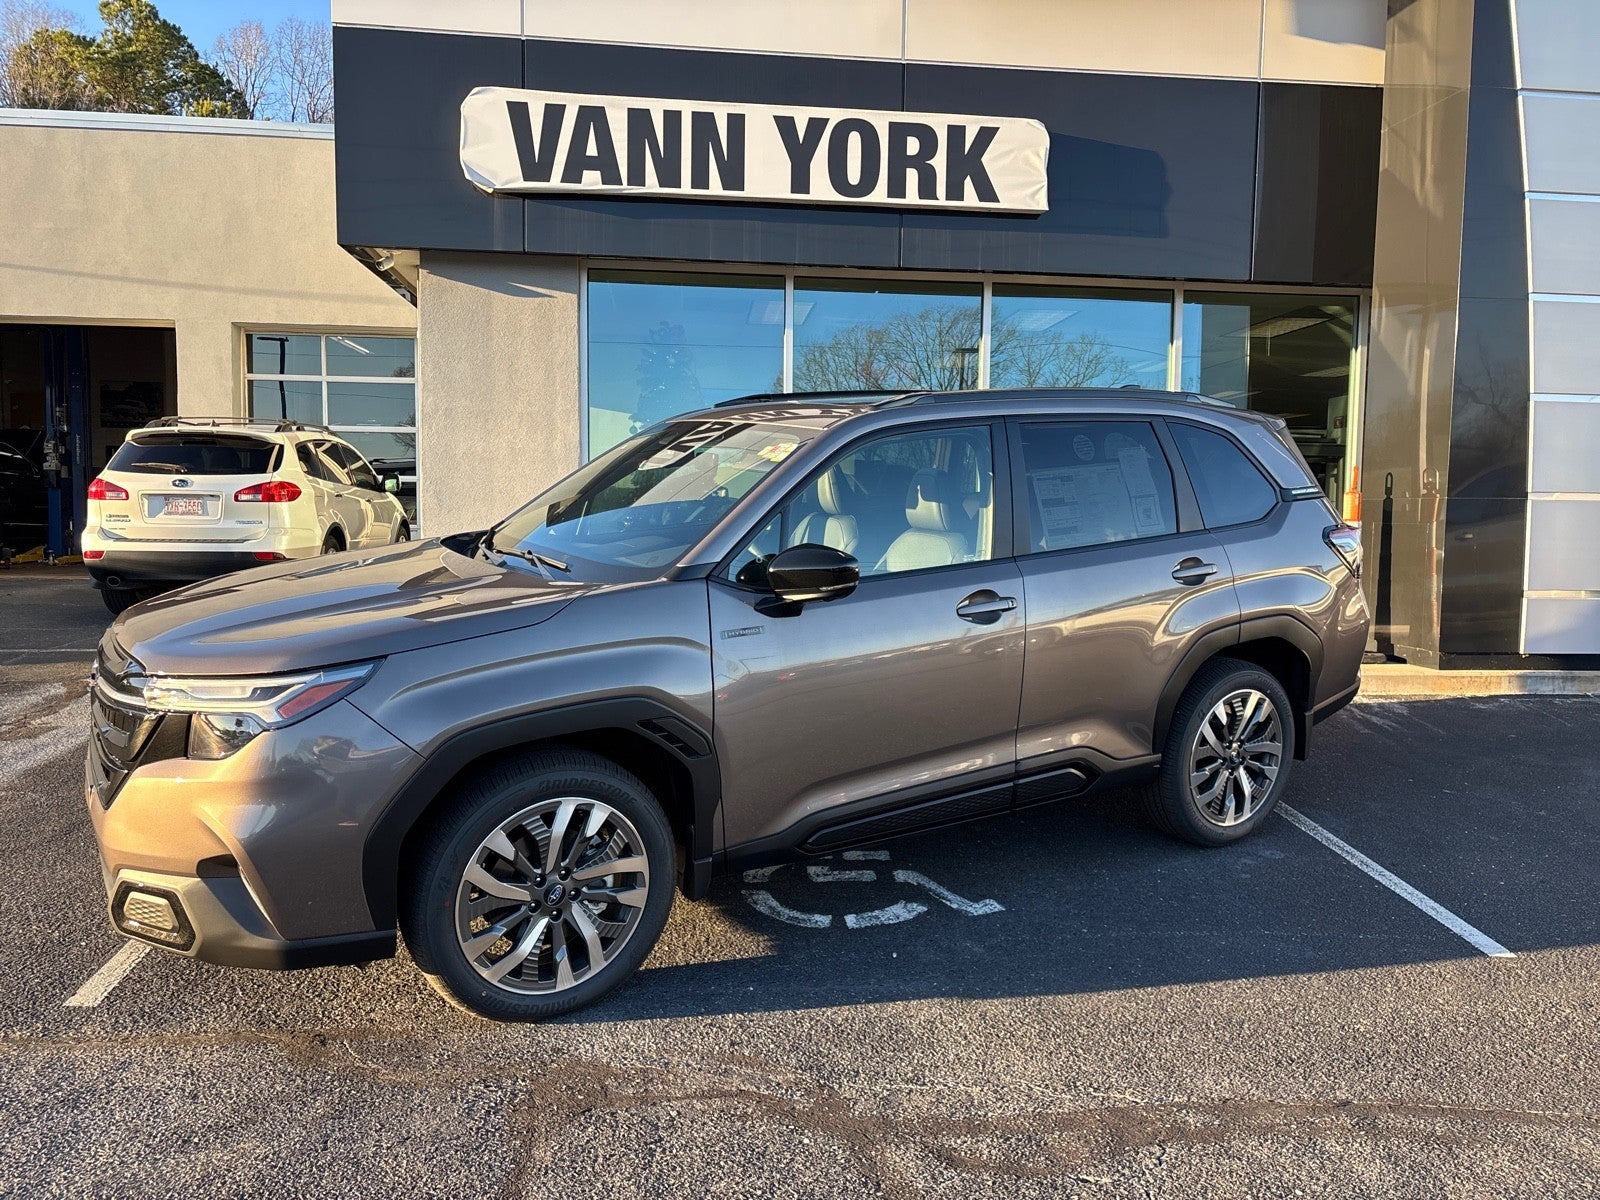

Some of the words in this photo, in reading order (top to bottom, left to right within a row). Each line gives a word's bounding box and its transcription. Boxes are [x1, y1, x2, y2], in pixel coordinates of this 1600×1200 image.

[506, 101, 746, 191] VANN
[773, 115, 1001, 203] YORK
[728, 628, 760, 637] HYBRID
[538, 777, 637, 804] BRIDGESTONE
